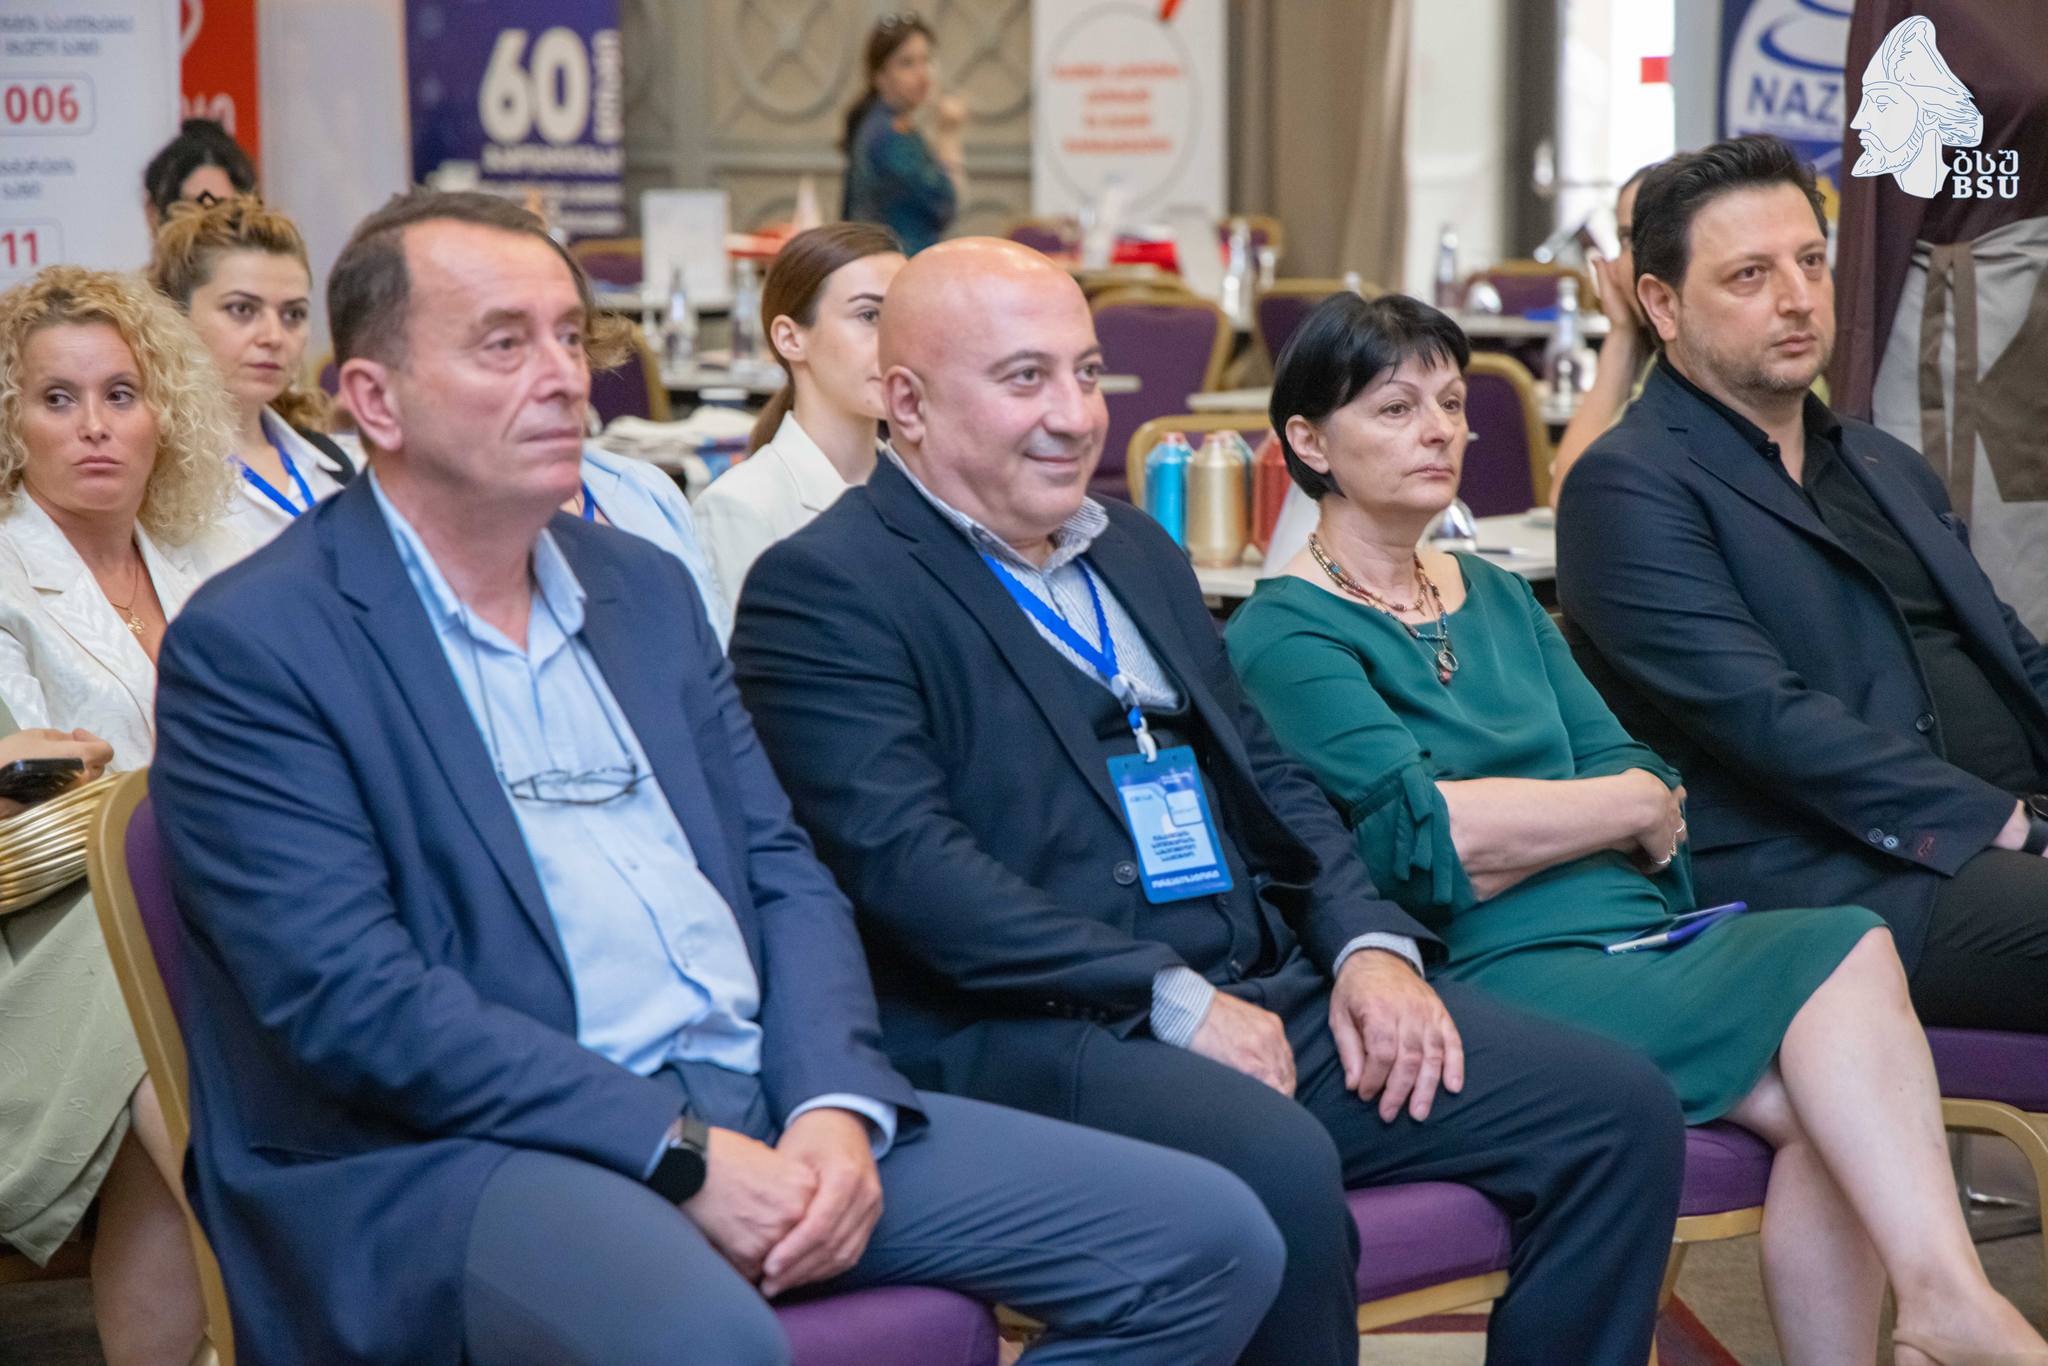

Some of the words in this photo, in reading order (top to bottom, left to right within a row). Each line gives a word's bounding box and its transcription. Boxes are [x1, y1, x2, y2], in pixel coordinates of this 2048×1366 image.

[5, 84, 79, 124] 006
[479, 27, 589, 143] 60
[1747, 73, 1839, 124] NAZ
